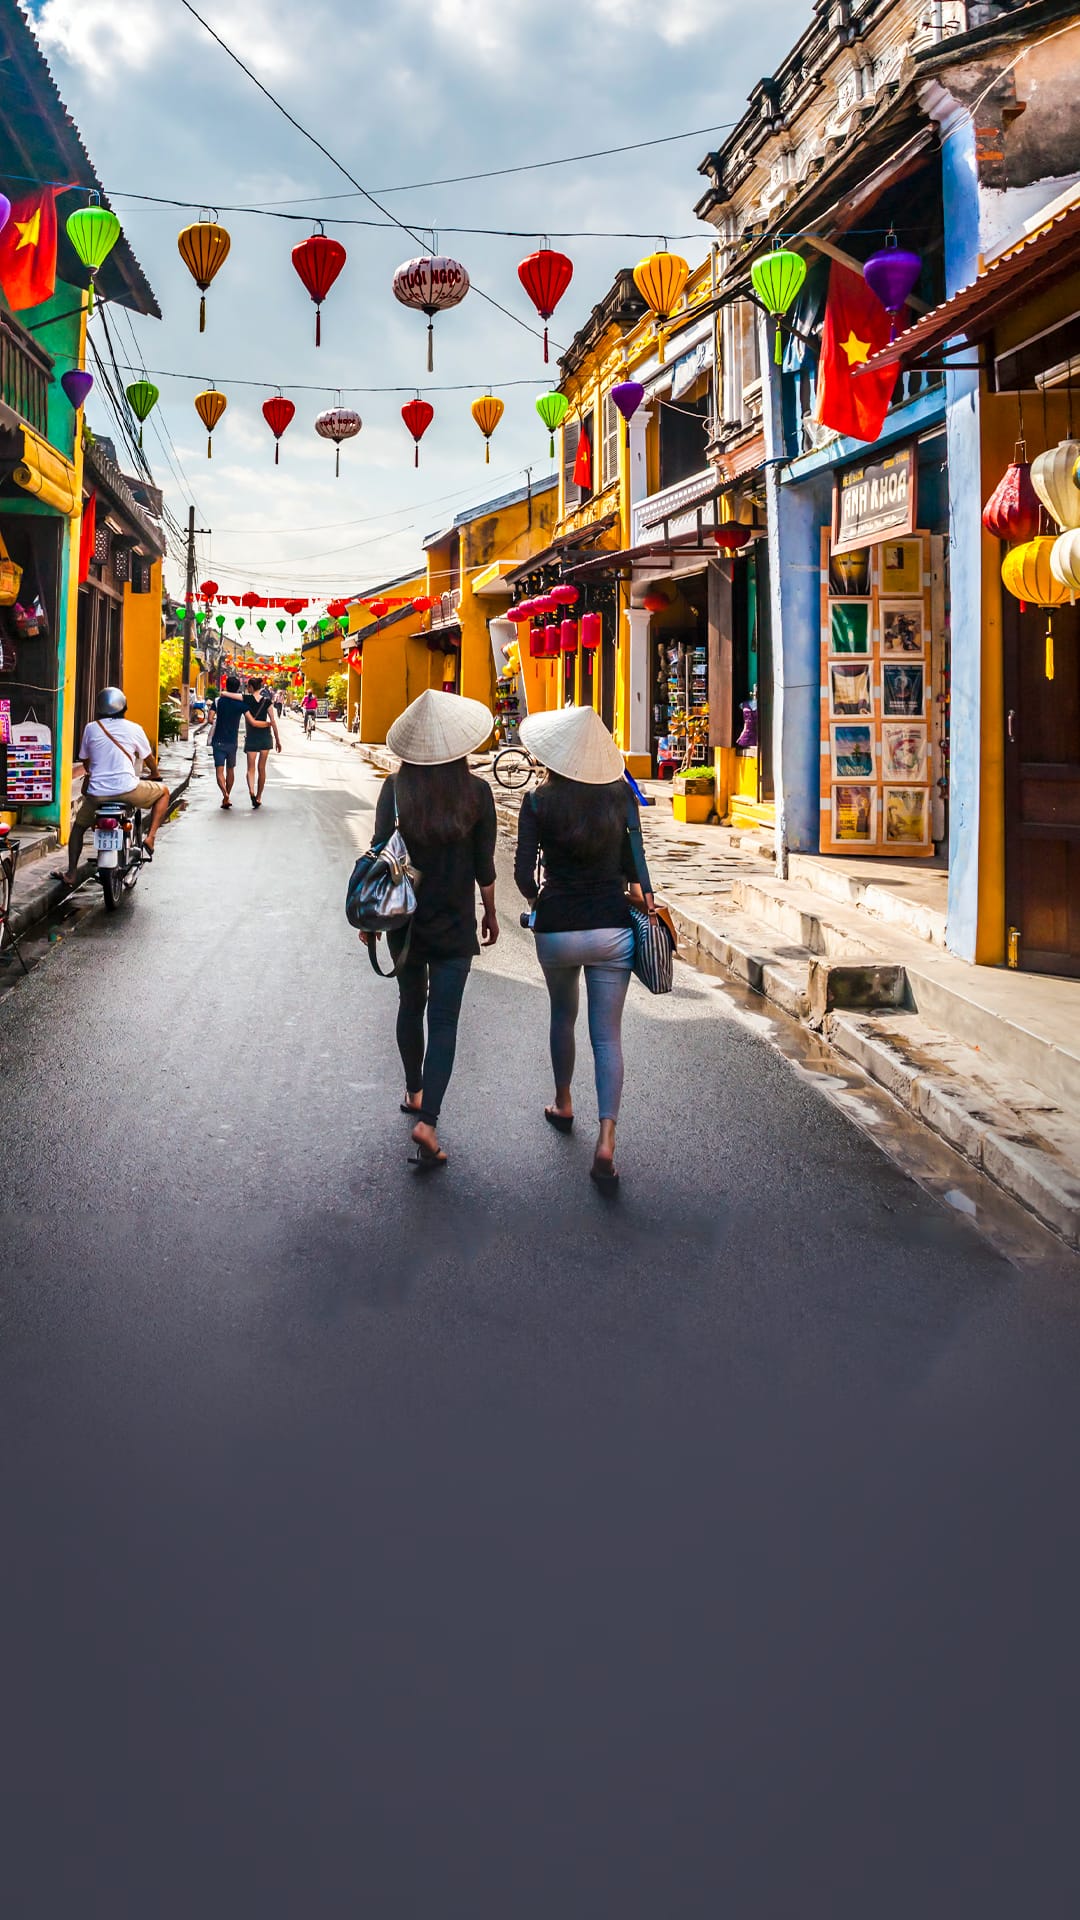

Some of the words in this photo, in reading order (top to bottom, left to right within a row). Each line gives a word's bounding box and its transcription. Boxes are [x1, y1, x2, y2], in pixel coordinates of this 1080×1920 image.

[431, 269, 461, 288] NGỌC
[843, 485, 867, 520] ANH
[870, 468, 907, 510] KHOA
